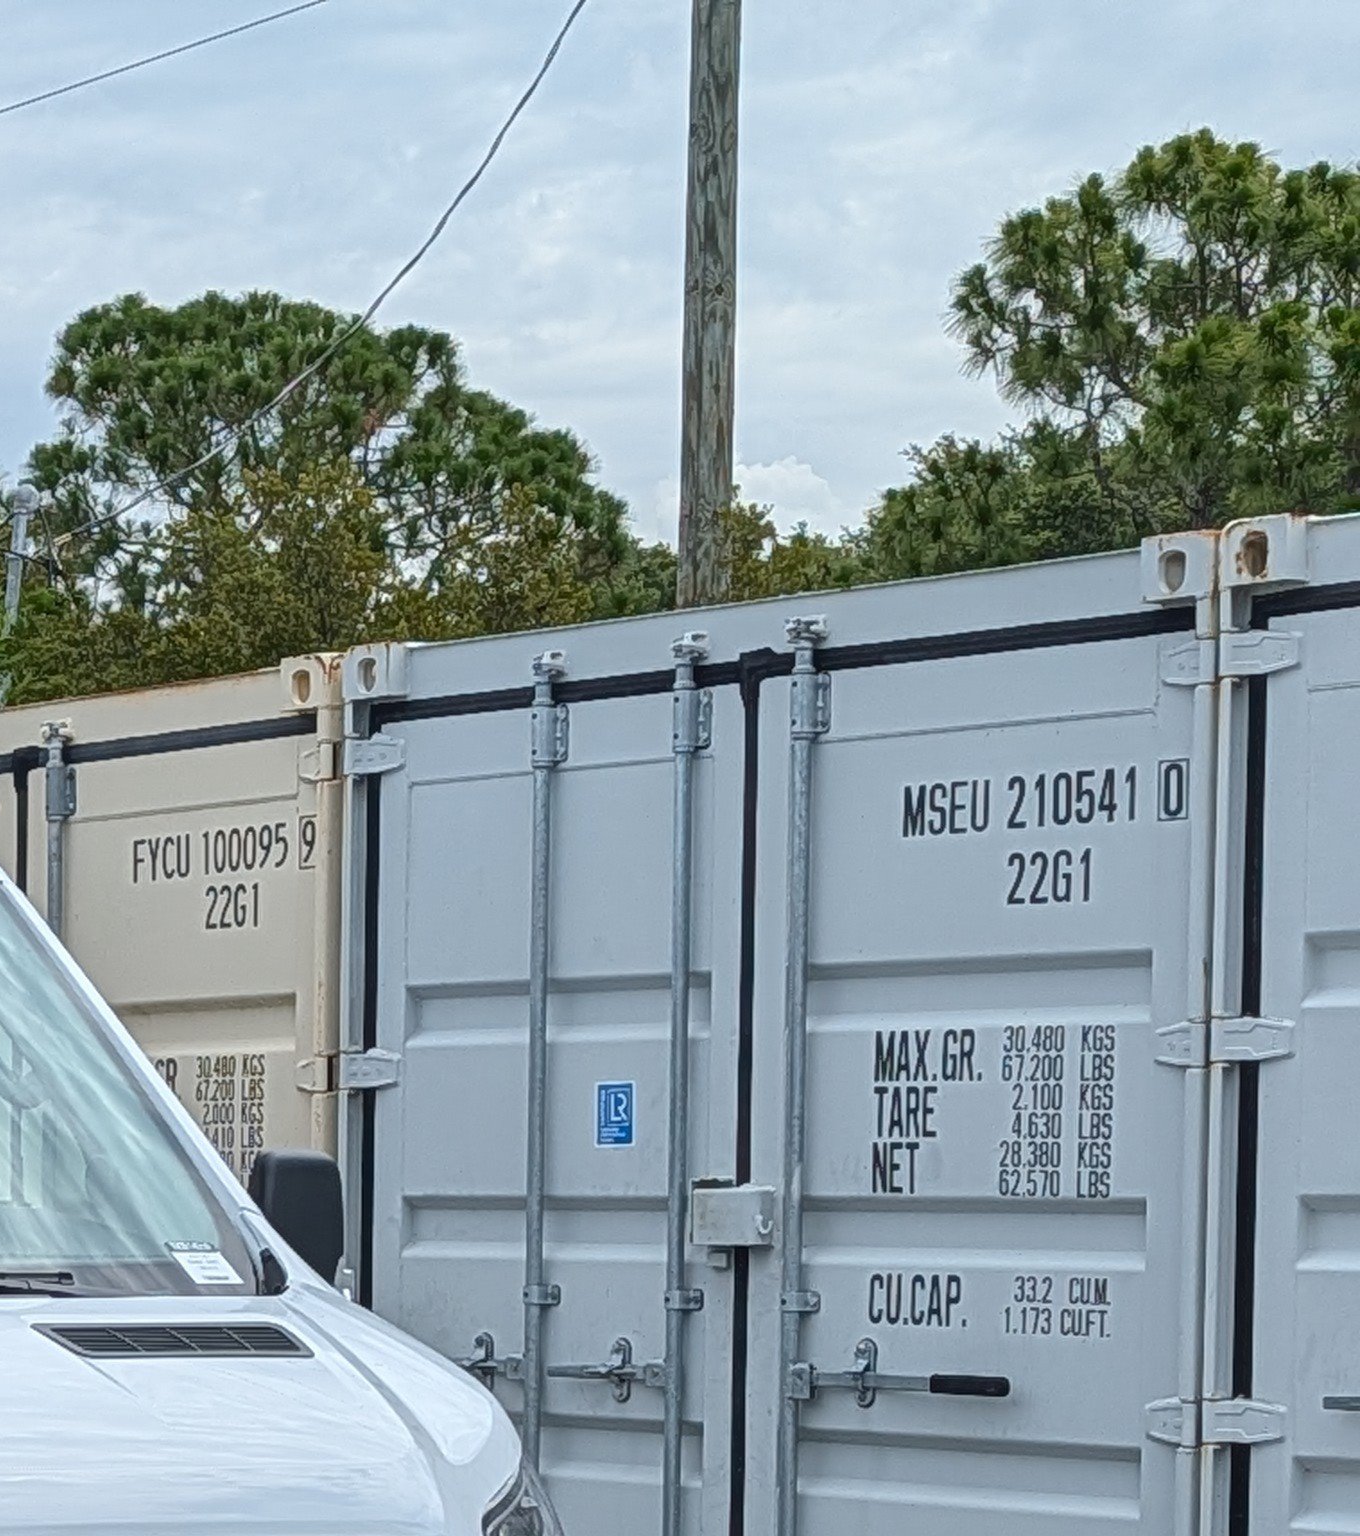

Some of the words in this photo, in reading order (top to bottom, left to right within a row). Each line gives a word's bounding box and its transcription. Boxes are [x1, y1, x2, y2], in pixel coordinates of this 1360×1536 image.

[902, 779, 990, 838] MSEU
[1007, 765, 1137, 830] 210541
[1162, 761, 1184, 818] 0
[132, 832, 191, 884] FYCU
[202, 822, 288, 877] 100095
[301, 817, 316, 865] 9
[1007, 847, 1092, 905] 22G1
[204, 883, 260, 930] 22G1
[241, 1054, 266, 1077] KGS
[873, 1028, 982, 1083] MAX.GR.
[1080, 1025, 1116, 1053] KGS
[1001, 1055, 1065, 1083] 67.200
[1079, 1055, 1115, 1083] LBS
[241, 1079, 265, 1101] LBS
[241, 1102, 265, 1125] KGS
[873, 1085, 939, 1139] TARE
[1078, 1083, 1114, 1111] KGS
[1077, 1112, 1113, 1141] LBS
[241, 1126, 265, 1148] LBS
[871, 1141, 920, 1195] NET
[1077, 1142, 1112, 1170] KGS
[998, 1170, 1061, 1198] 62.570
[1076, 1171, 1112, 1199] LBS
[868, 1273, 968, 1328] CU.CAP.
[1013, 1276, 1054, 1303] 33.2
[1003, 1308, 1053, 1335] 1.173
